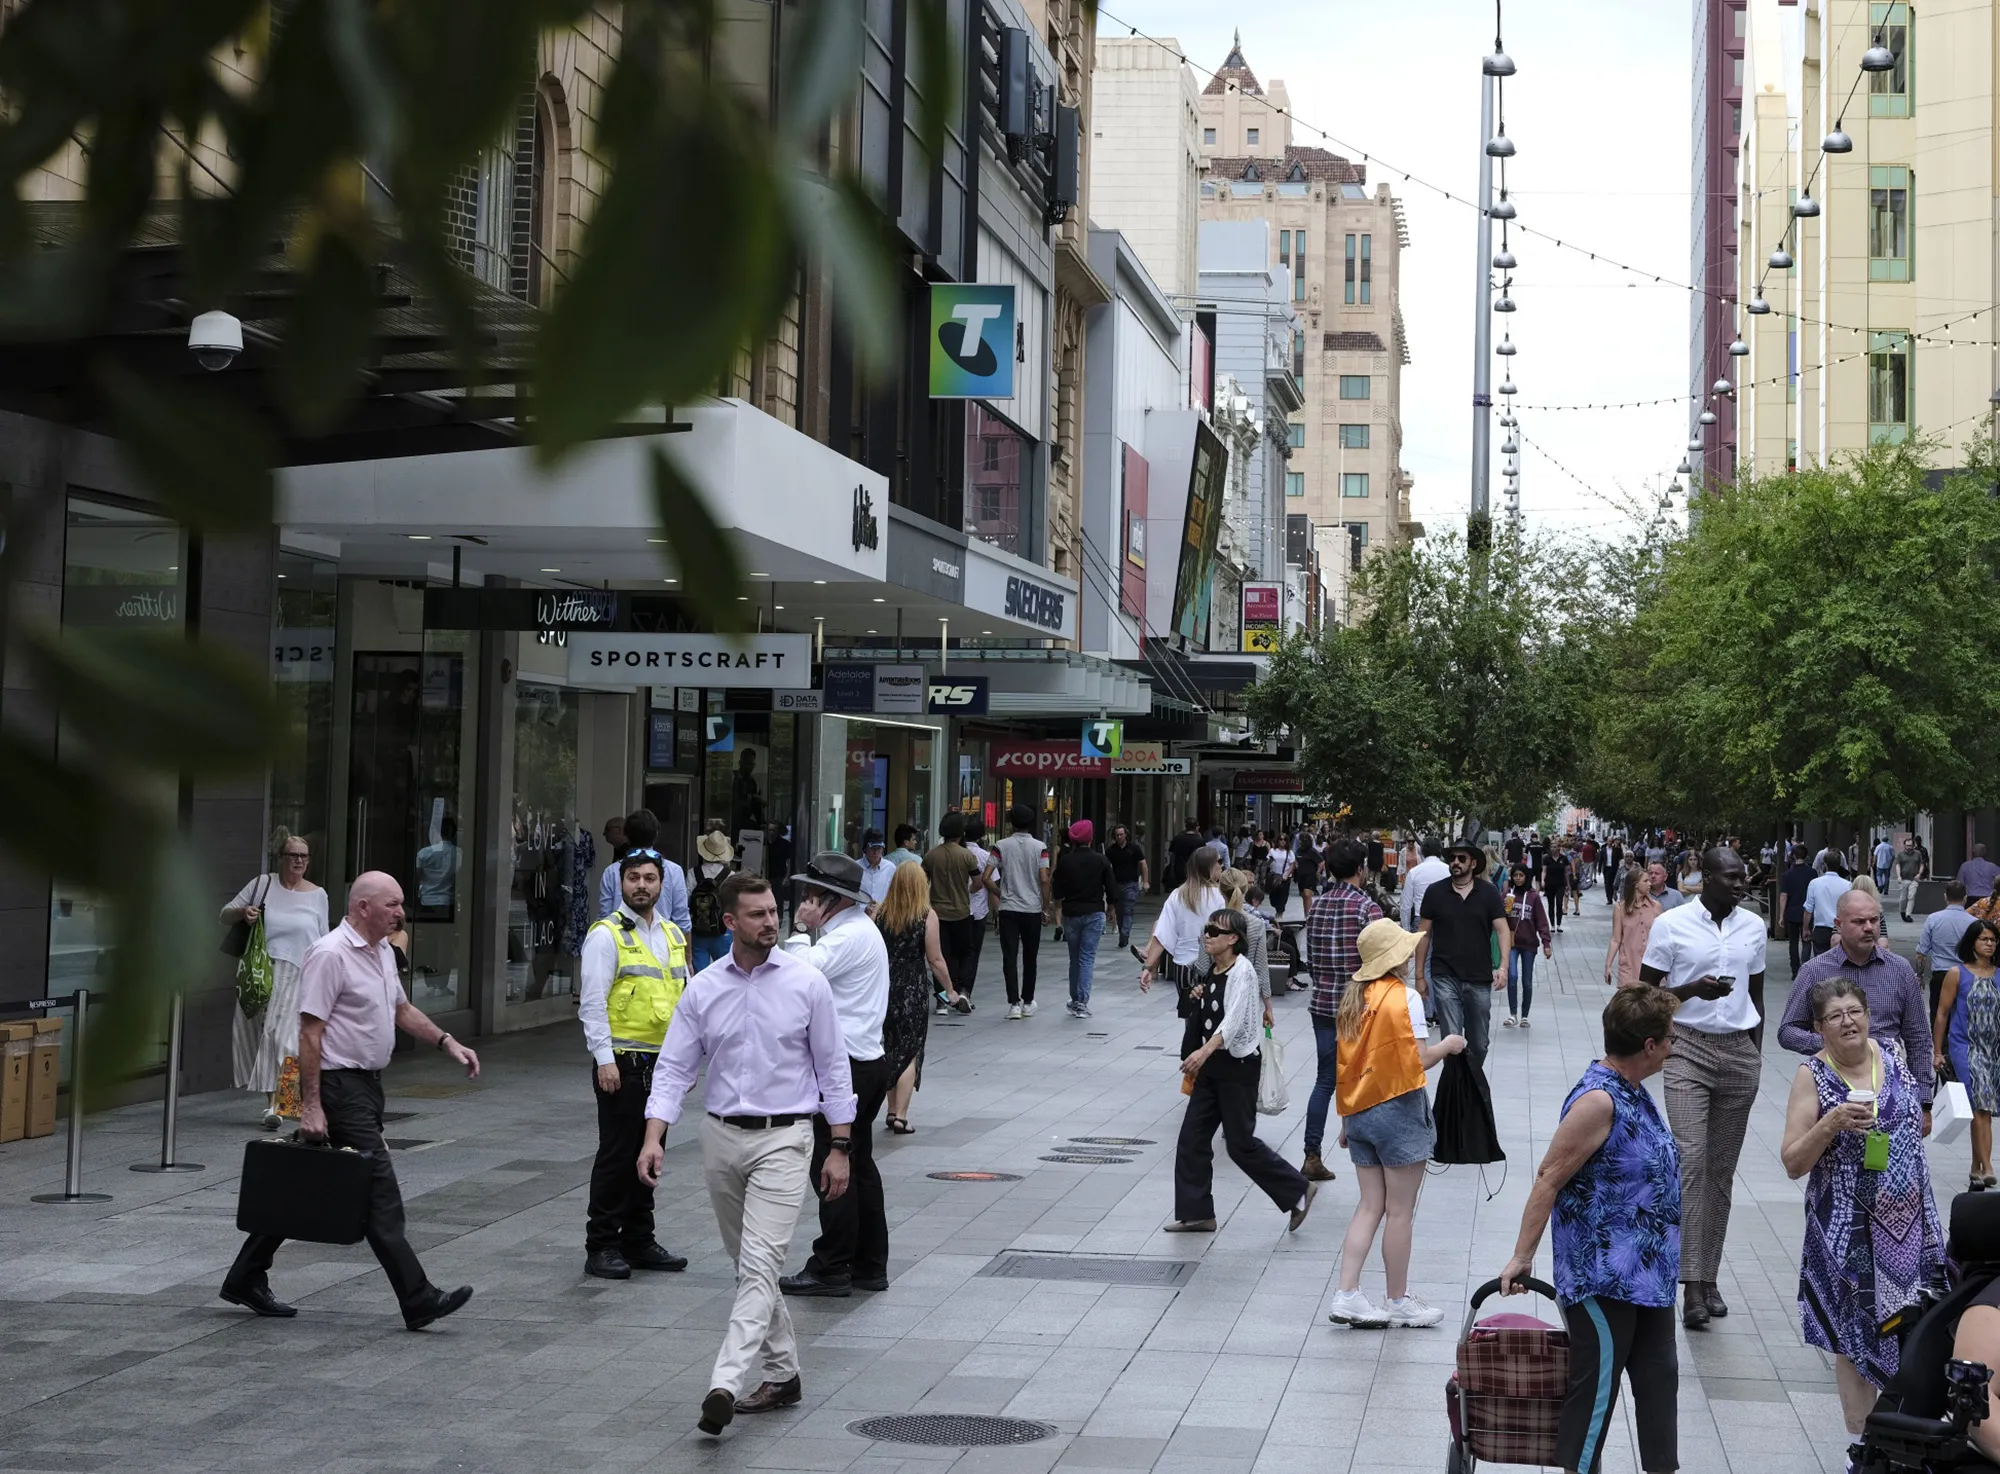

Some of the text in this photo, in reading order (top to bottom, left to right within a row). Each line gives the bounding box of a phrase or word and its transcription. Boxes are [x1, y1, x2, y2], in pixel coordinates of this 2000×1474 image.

[952, 304, 1003, 358] T
[537, 595, 601, 625] Wittner
[1005, 576, 1064, 630] SKECHERS
[590, 650, 786, 669] SPORTSCRAFT
[827, 669, 871, 679] Adelaide
[796, 695, 818, 703] DATA
[1093, 722, 1115, 746] T
[1011, 751, 1101, 771] copycat
[1238, 777, 1267, 785] FLIGHT
[527, 821, 557, 851] LOVE
[534, 871, 547, 899] IN
[523, 920, 555, 948] LILAC
[28, 999, 57, 1010] NESPRESSO
